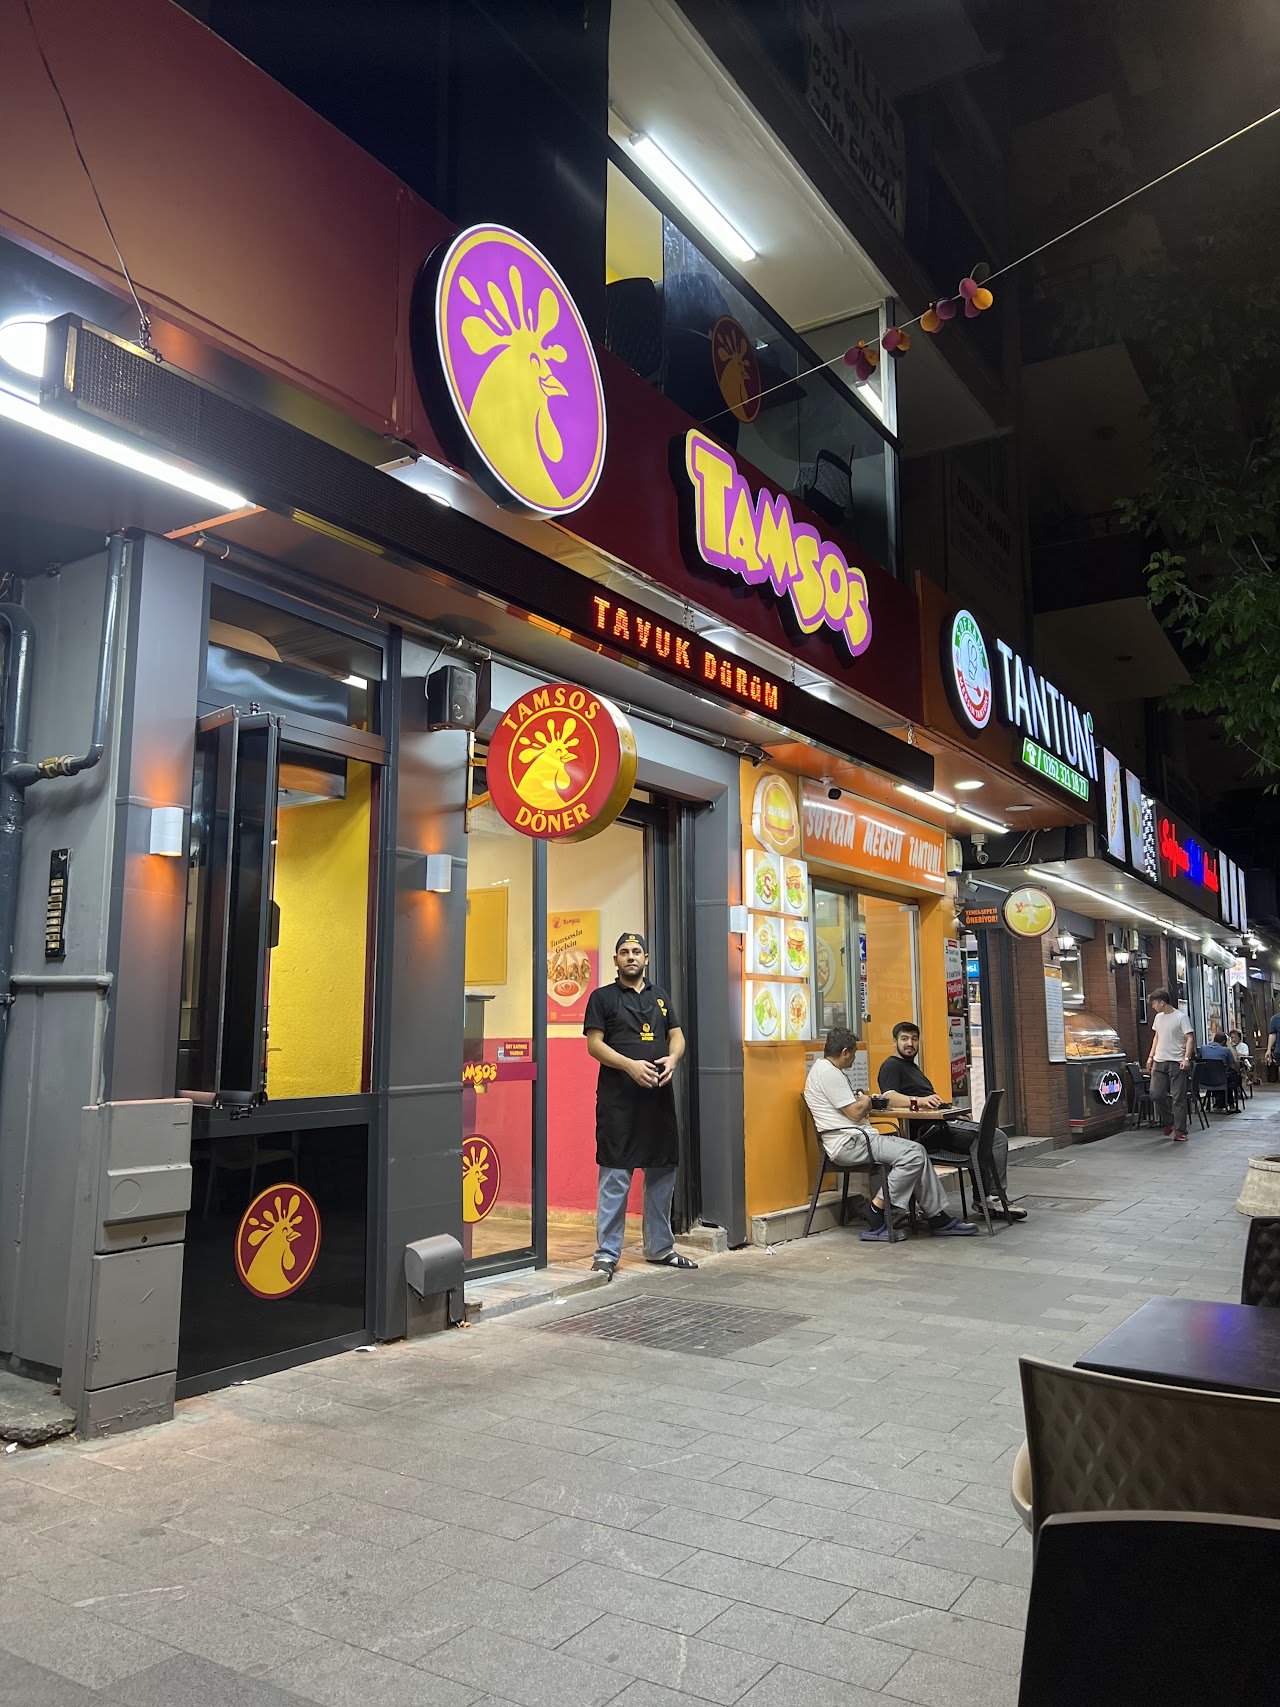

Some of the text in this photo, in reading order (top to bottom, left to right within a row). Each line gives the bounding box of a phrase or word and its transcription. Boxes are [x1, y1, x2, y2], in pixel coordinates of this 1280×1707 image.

[690, 436, 870, 652] TAMSOS
[594, 596, 690, 669] TAVUK
[502, 687, 600, 731] TAMSOS
[1043, 753, 1060, 780] 0262
[514, 803, 591, 833] DÖNER
[806, 803, 856, 850] SOFRAM
[550, 929, 583, 948] Tamsosla
[555, 940, 577, 954] Gelsin
[948, 981, 962, 995] Hediye
[462, 1063, 497, 1085] MSOS
[951, 1060, 966, 1074] Hediye
